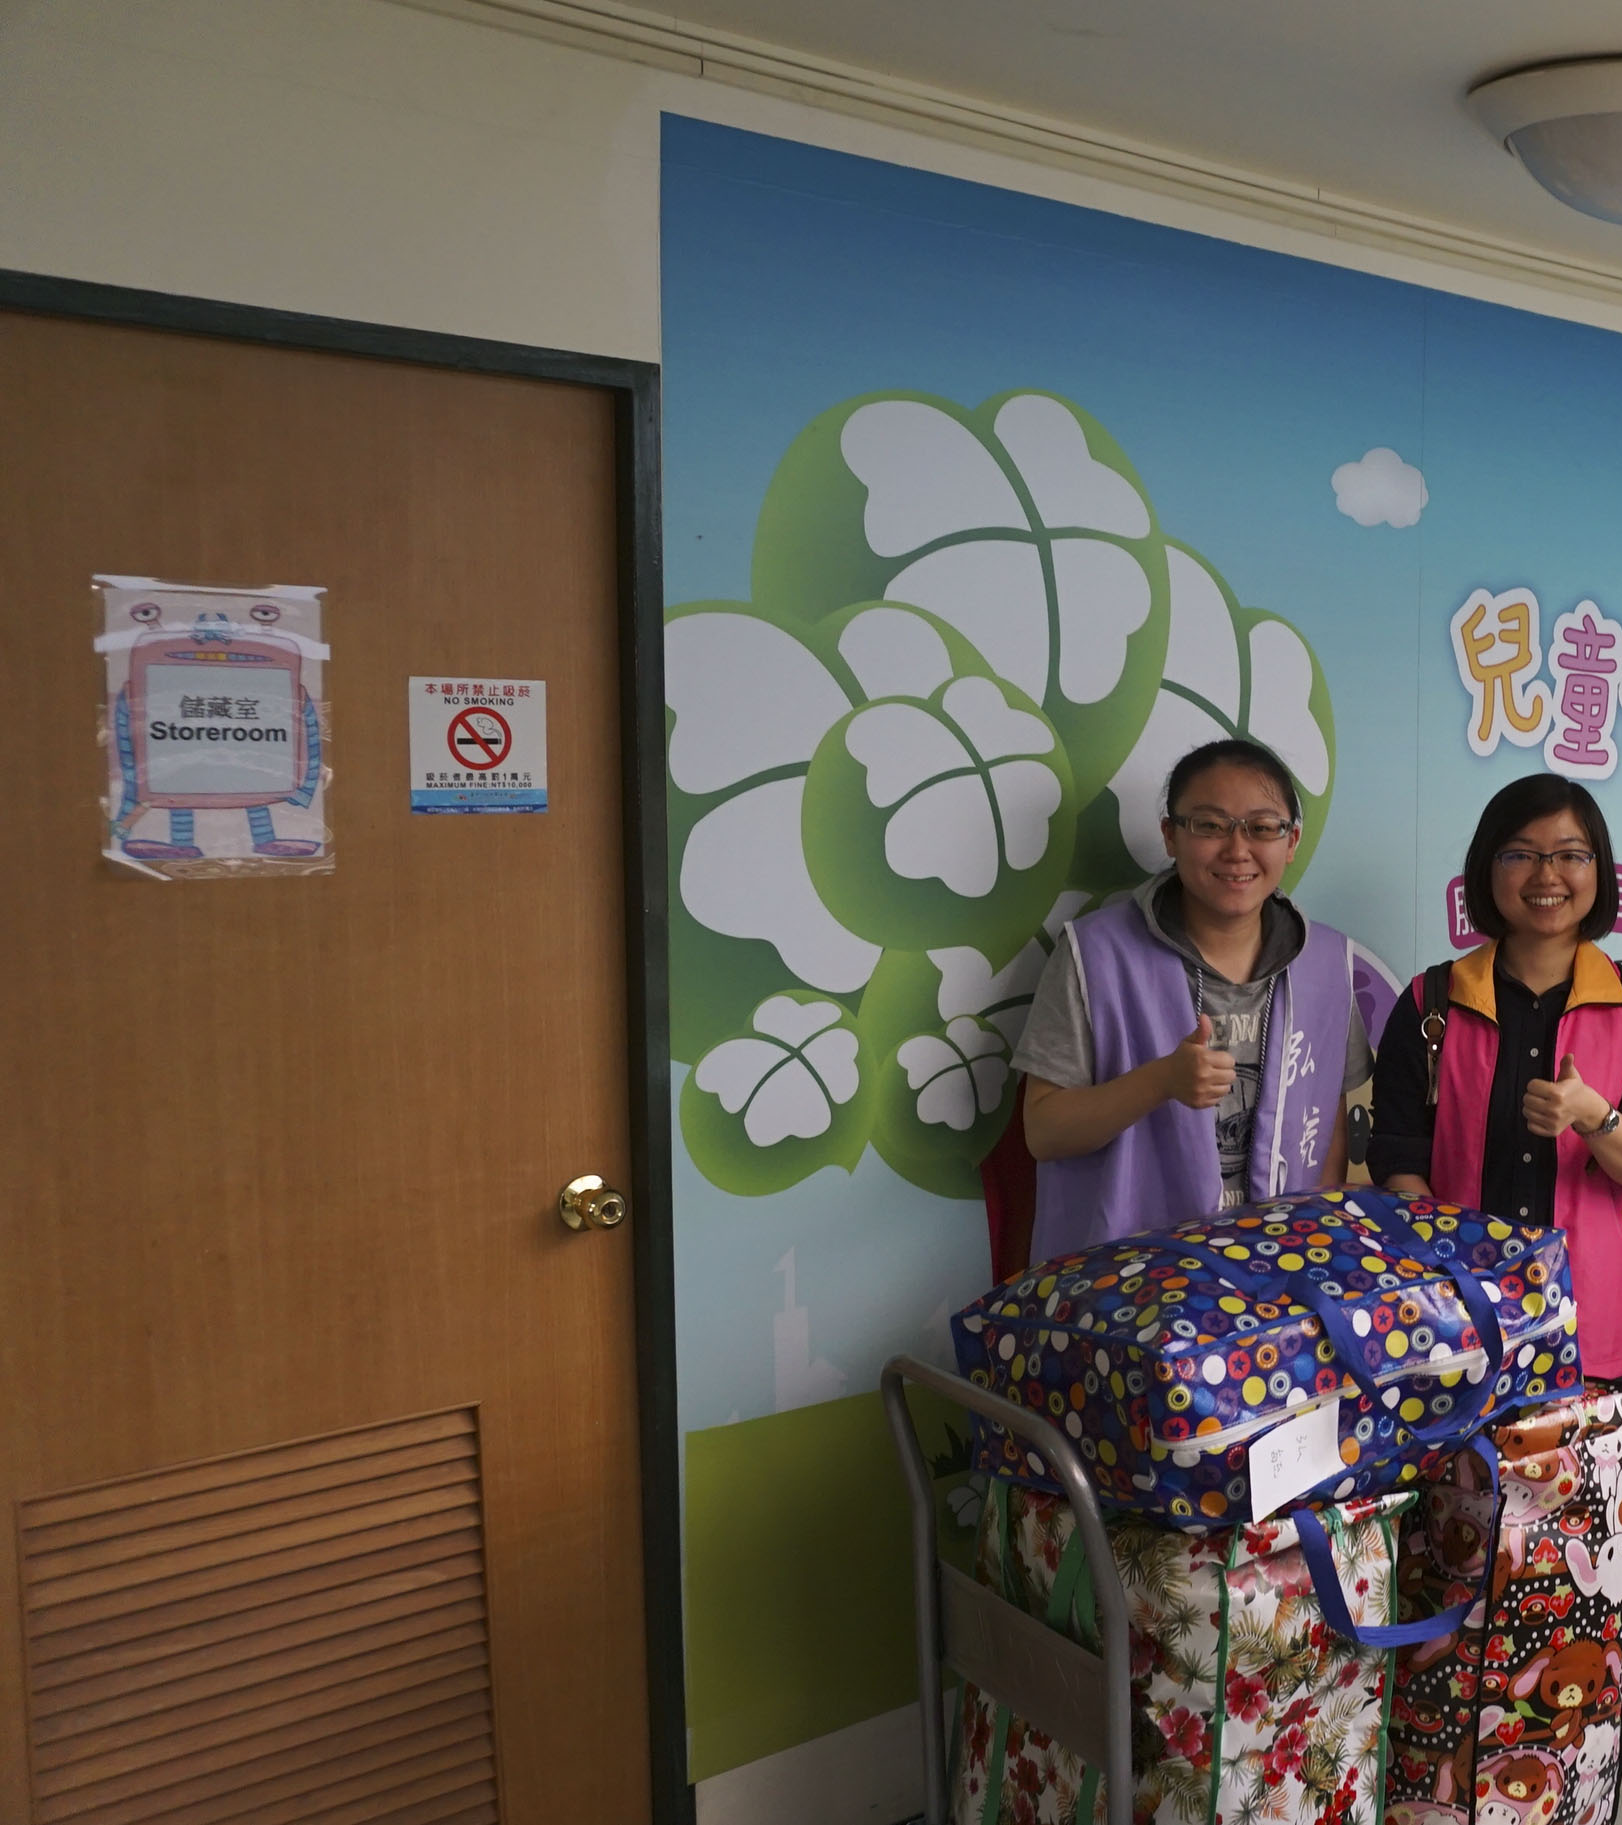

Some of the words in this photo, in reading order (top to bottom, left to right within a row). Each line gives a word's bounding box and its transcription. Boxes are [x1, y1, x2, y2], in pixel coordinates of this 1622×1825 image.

[425, 683, 531, 698] 本場所禁止吸菸
[180, 695, 260, 720] 儲藏室
[444, 697, 460, 705] NO
[464, 697, 514, 706] SMOKING
[150, 721, 287, 742] Storeroom
